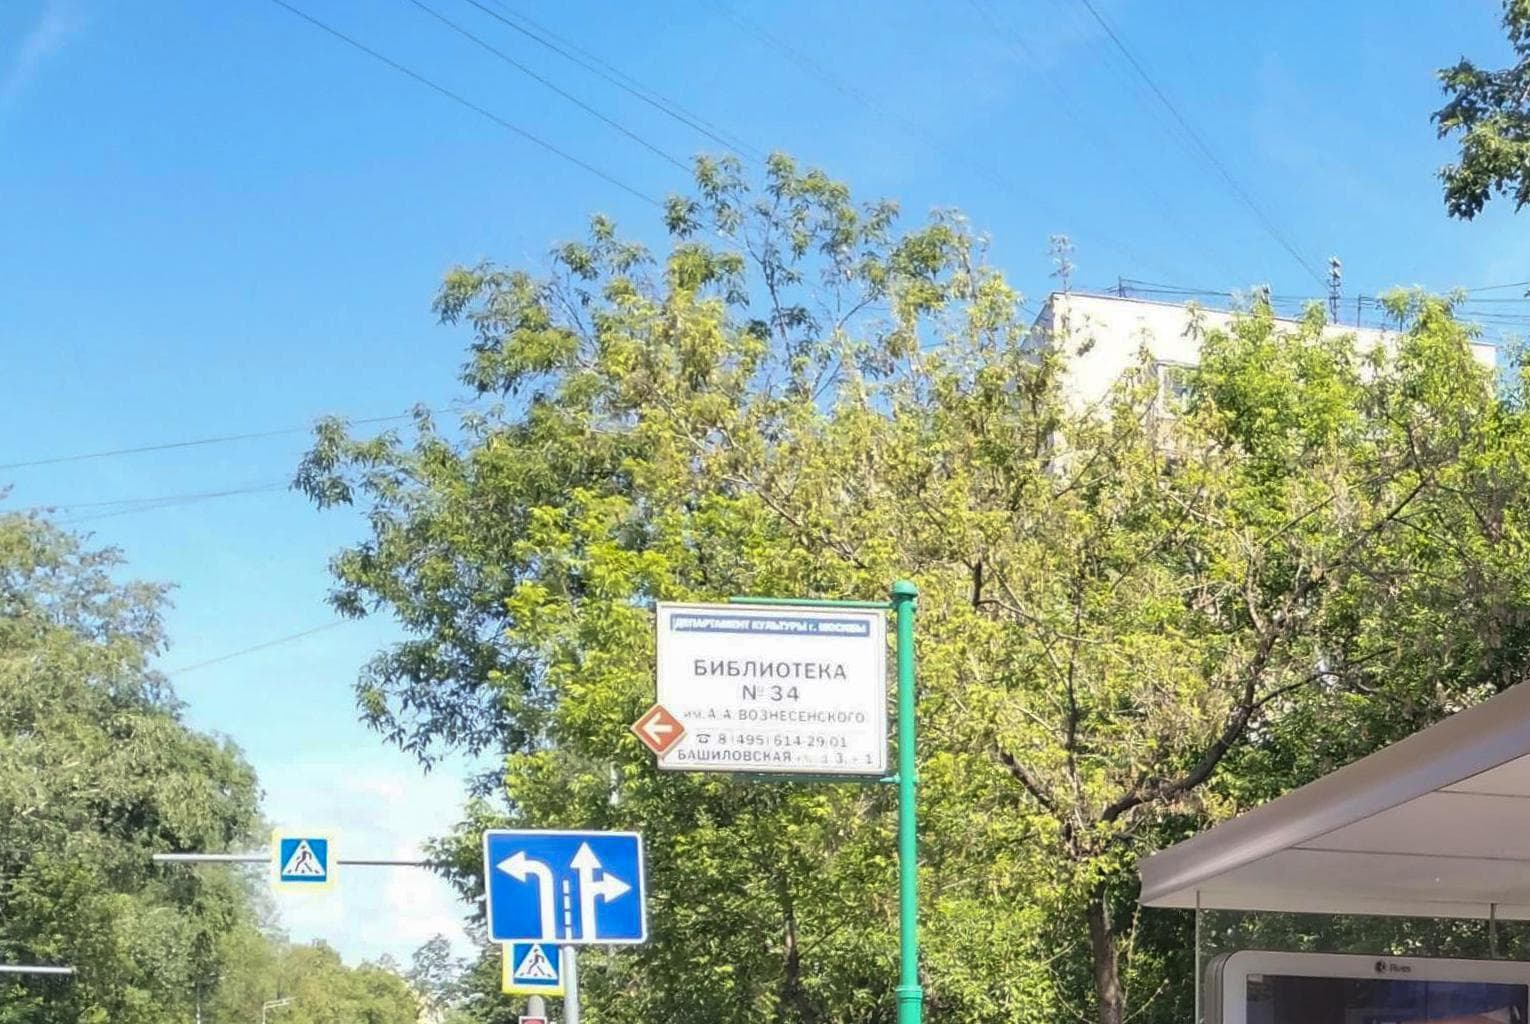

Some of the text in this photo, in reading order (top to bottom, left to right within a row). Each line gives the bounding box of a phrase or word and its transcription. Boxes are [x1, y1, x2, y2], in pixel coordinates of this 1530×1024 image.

[694, 659, 847, 680] БИБЛИОТЕКА
[770, 684, 800, 701] 34
[739, 708, 866, 723] ВОЗНЕСЕНСКОГО
[718, 733, 727, 745] 8
[678, 749, 792, 763] БАШИЛОВСКАЯ
